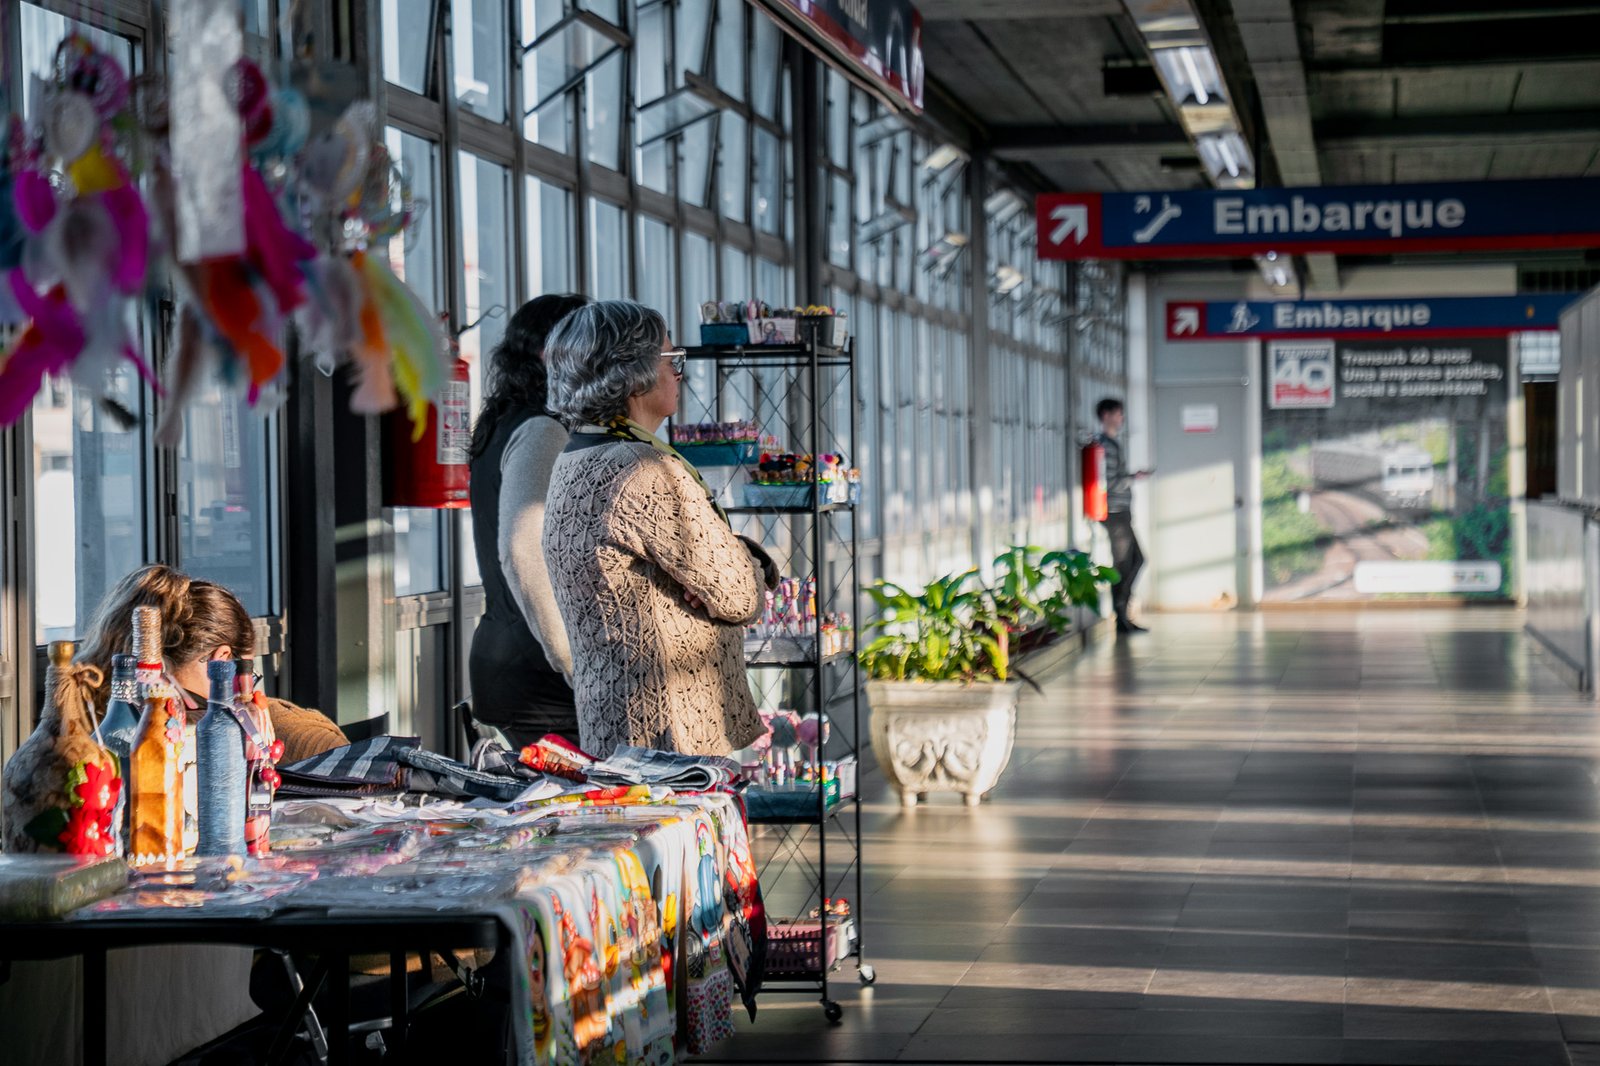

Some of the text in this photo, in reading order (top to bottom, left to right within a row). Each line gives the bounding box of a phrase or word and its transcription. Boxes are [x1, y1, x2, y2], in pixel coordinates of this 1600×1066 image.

[1214, 195, 1466, 237] Embarque
[1274, 302, 1431, 332] Embarque
[1275, 360, 1332, 393] 40
[1342, 367, 1377, 382] Uma
[1379, 367, 1442, 384] empresa
